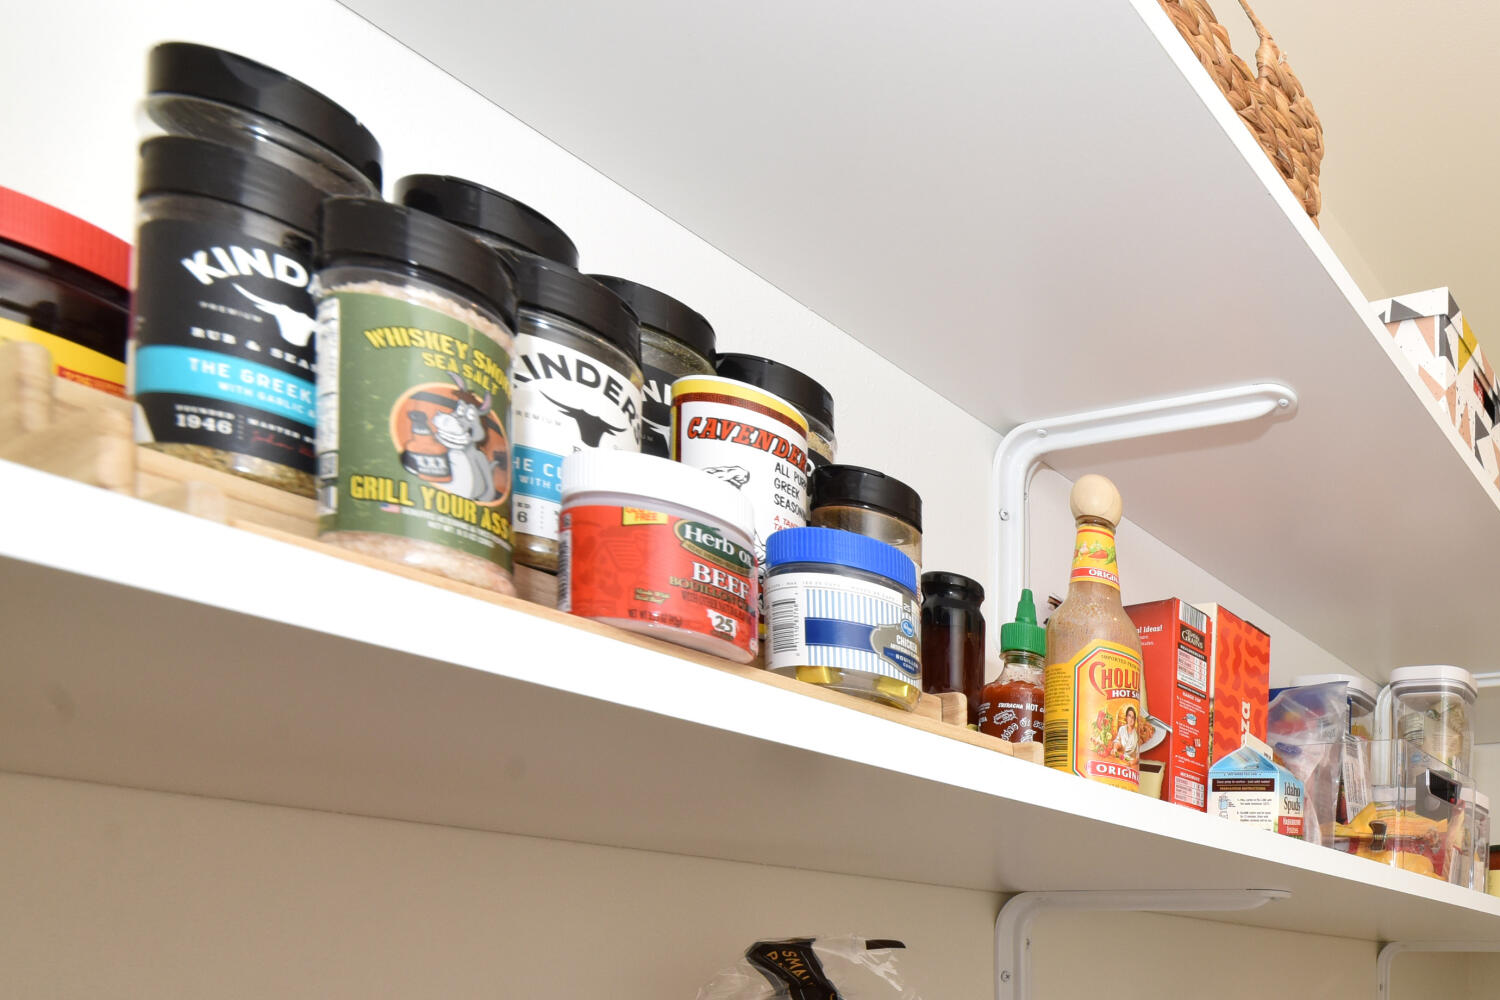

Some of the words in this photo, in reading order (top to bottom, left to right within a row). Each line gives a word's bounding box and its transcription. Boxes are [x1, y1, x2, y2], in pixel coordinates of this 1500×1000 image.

[181, 245, 321, 298] KIND
[190, 326, 236, 345] RUB
[245, 340, 261, 352] &
[364, 326, 469, 360] WHISKEY
[188, 357, 231, 378] THE
[240, 368, 314, 404] GREEK
[421, 351, 459, 374] SEA
[462, 363, 499, 396] SALT
[217, 381, 254, 397] WITH
[175, 413, 233, 435] 1946
[774, 462, 791, 479] ALL
[350, 475, 415, 507] GRILL
[420, 485, 479, 524] YOUR
[773, 477, 800, 500] GREEK
[684, 524, 735, 556] Herb
[692, 561, 751, 600] BEEF
[714, 615, 734, 633] 25
[1111, 689, 1130, 698] HOT
[1025, 702, 1039, 712] HOT
[1284, 781, 1301, 796] Idaho
[1284, 796, 1301, 814] Spuds
